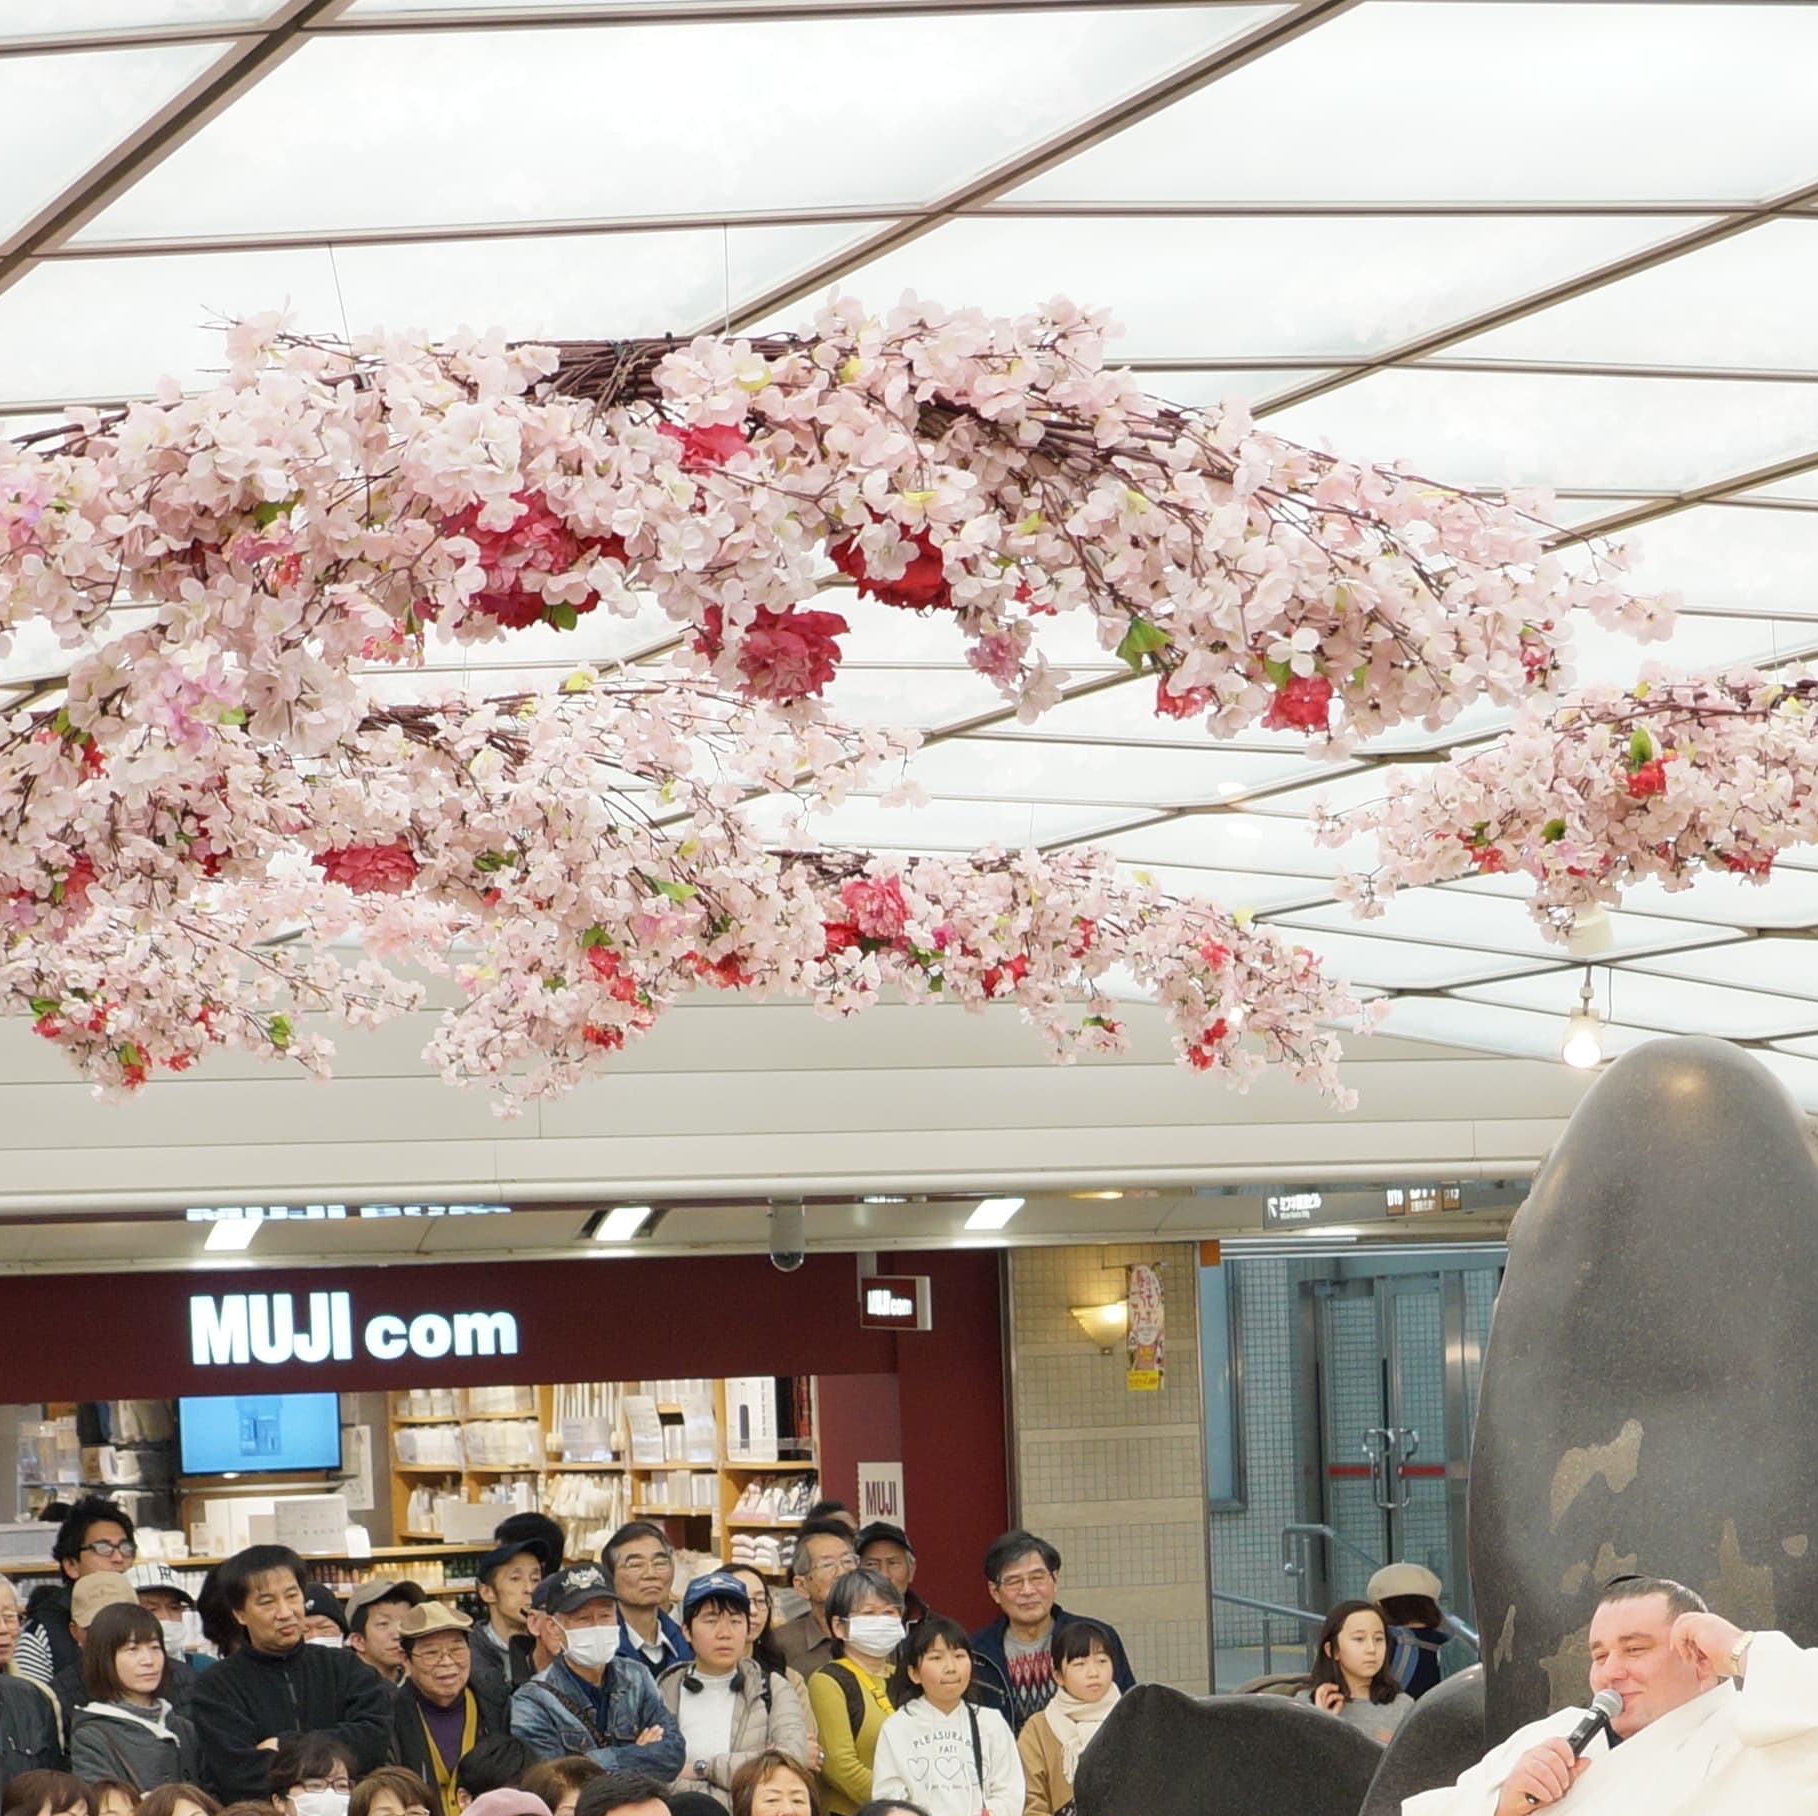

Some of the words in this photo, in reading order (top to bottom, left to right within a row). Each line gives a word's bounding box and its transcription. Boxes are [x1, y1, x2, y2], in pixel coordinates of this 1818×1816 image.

[190, 1292, 353, 1365] MUJI
[364, 1311, 518, 1360] com
[866, 1480, 897, 1516] MUJI
